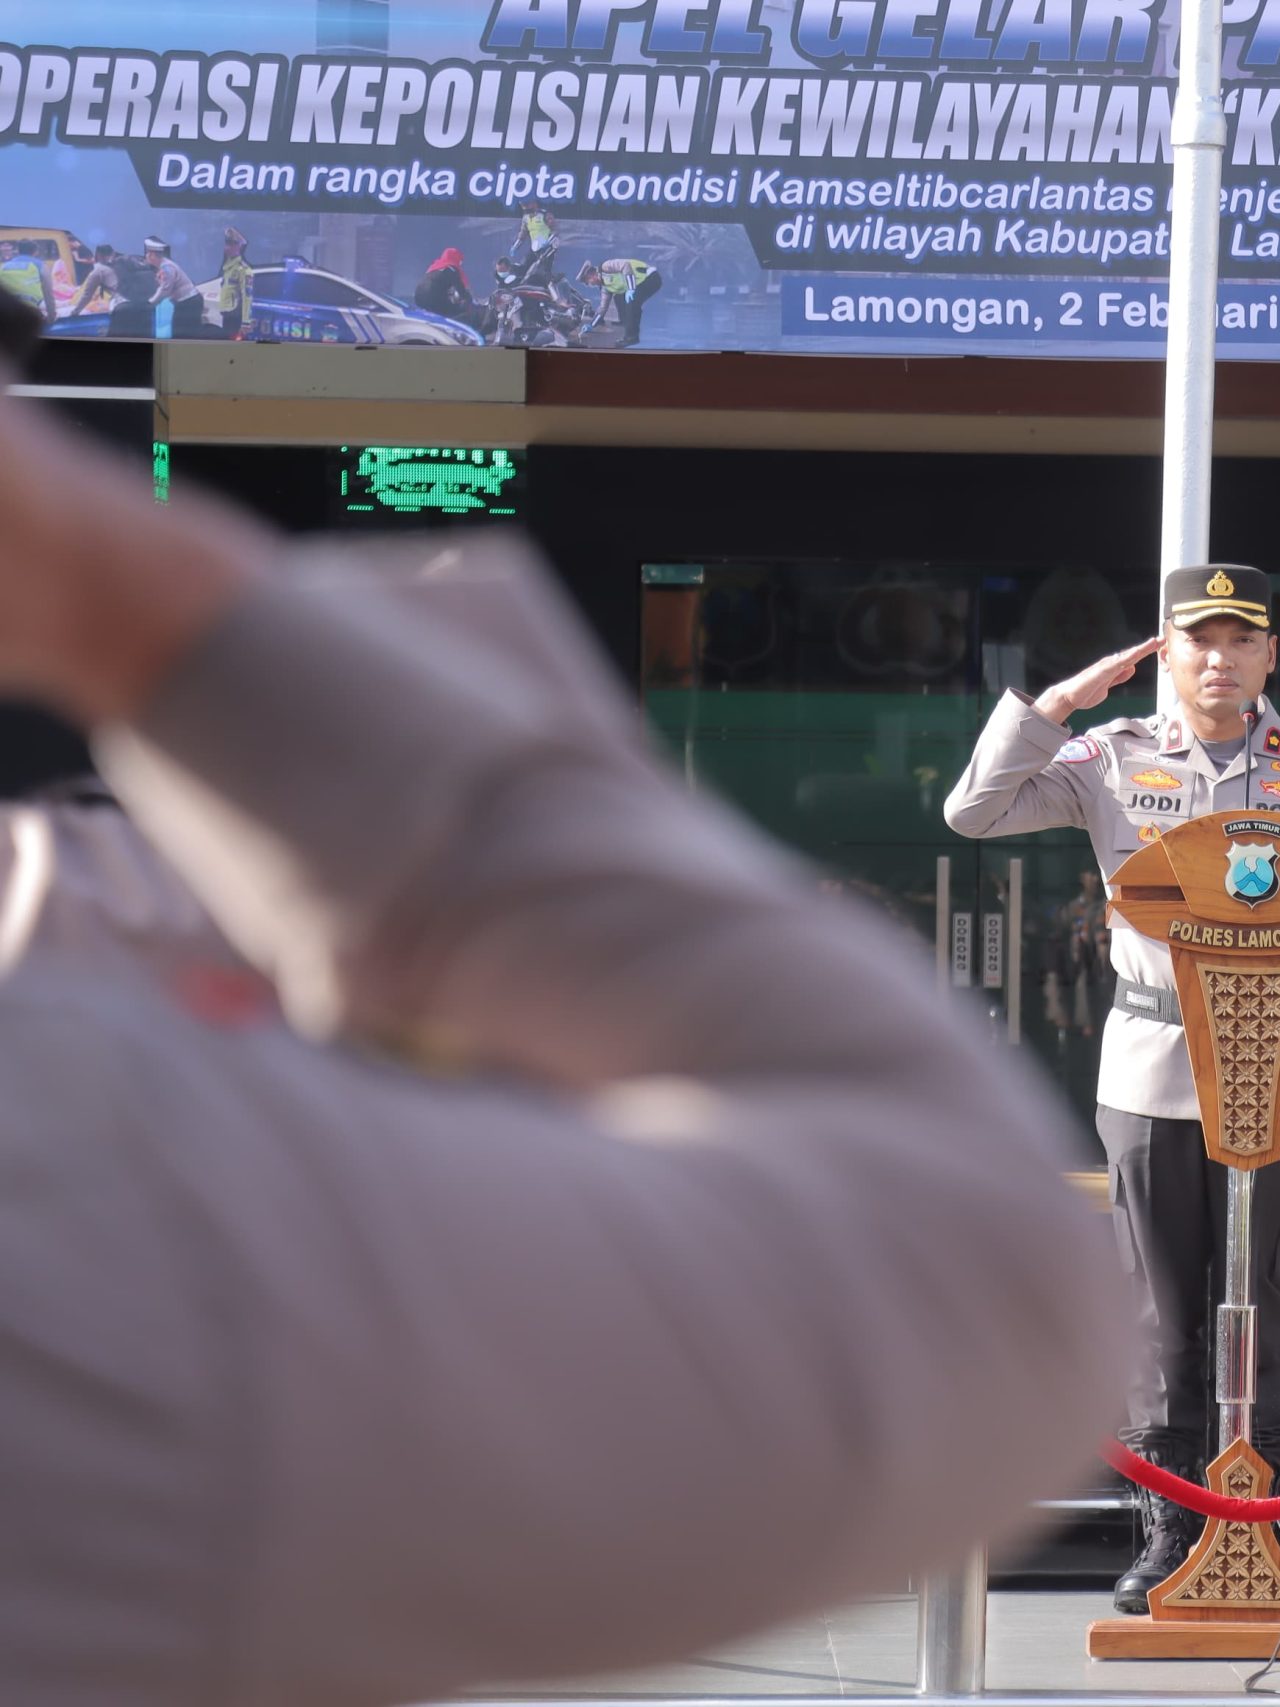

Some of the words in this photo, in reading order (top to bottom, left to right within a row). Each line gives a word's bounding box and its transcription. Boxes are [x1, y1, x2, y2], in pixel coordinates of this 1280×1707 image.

[798, 0, 1154, 62] GELAR
[289, 63, 701, 153] KEPOLISIAN
[710, 76, 1177, 165] KEWILAYAHAN
[157, 153, 295, 191] Dalam
[308, 160, 456, 203] rangka
[468, 164, 575, 207] cipta
[587, 165, 739, 203] kondisi
[750, 169, 1154, 212] Kamseltibcarlantas
[775, 214, 815, 250] di
[826, 216, 982, 260] wilayah
[994, 218, 1172, 263] Kabupat
[804, 286, 1045, 333] Lamongan,
[1058, 291, 1084, 327] 2
[1097, 292, 1278, 330] Febari
[1126, 793, 1182, 813] JODI
[1227, 822, 1252, 833] JAWA
[1253, 822, 1280, 835] TIMUR
[956, 918, 967, 971] DORONG
[988, 919, 999, 972] DORONG
[1168, 920, 1234, 948] POLRES
